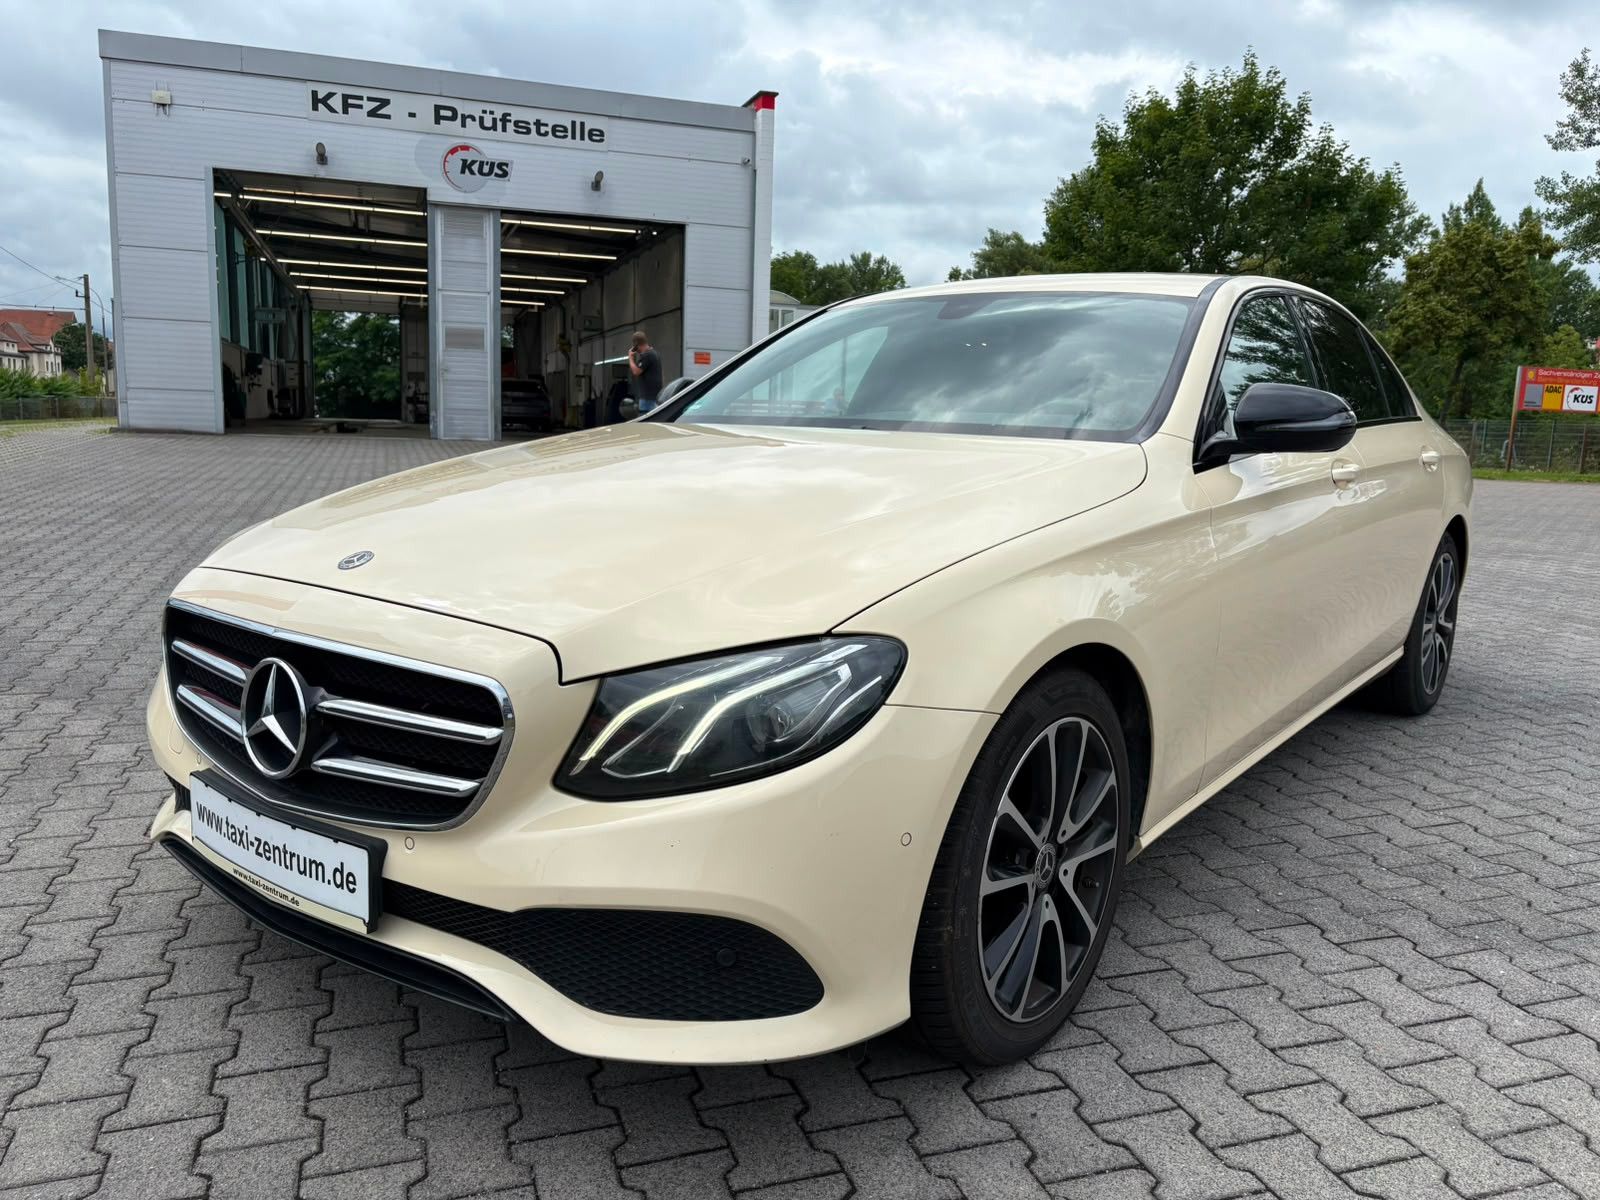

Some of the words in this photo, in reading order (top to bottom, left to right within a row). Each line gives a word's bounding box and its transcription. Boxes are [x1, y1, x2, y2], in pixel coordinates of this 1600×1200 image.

[311, 90, 391, 120] KFZ
[434, 104, 605, 143] Prüfstelle
[460, 158, 510, 179] KÜS
[1545, 385, 1562, 394] ADAC
[196, 801, 357, 894] www.taxi-zentrum.de
[232, 867, 300, 907] www.taxi-zentrum.de
